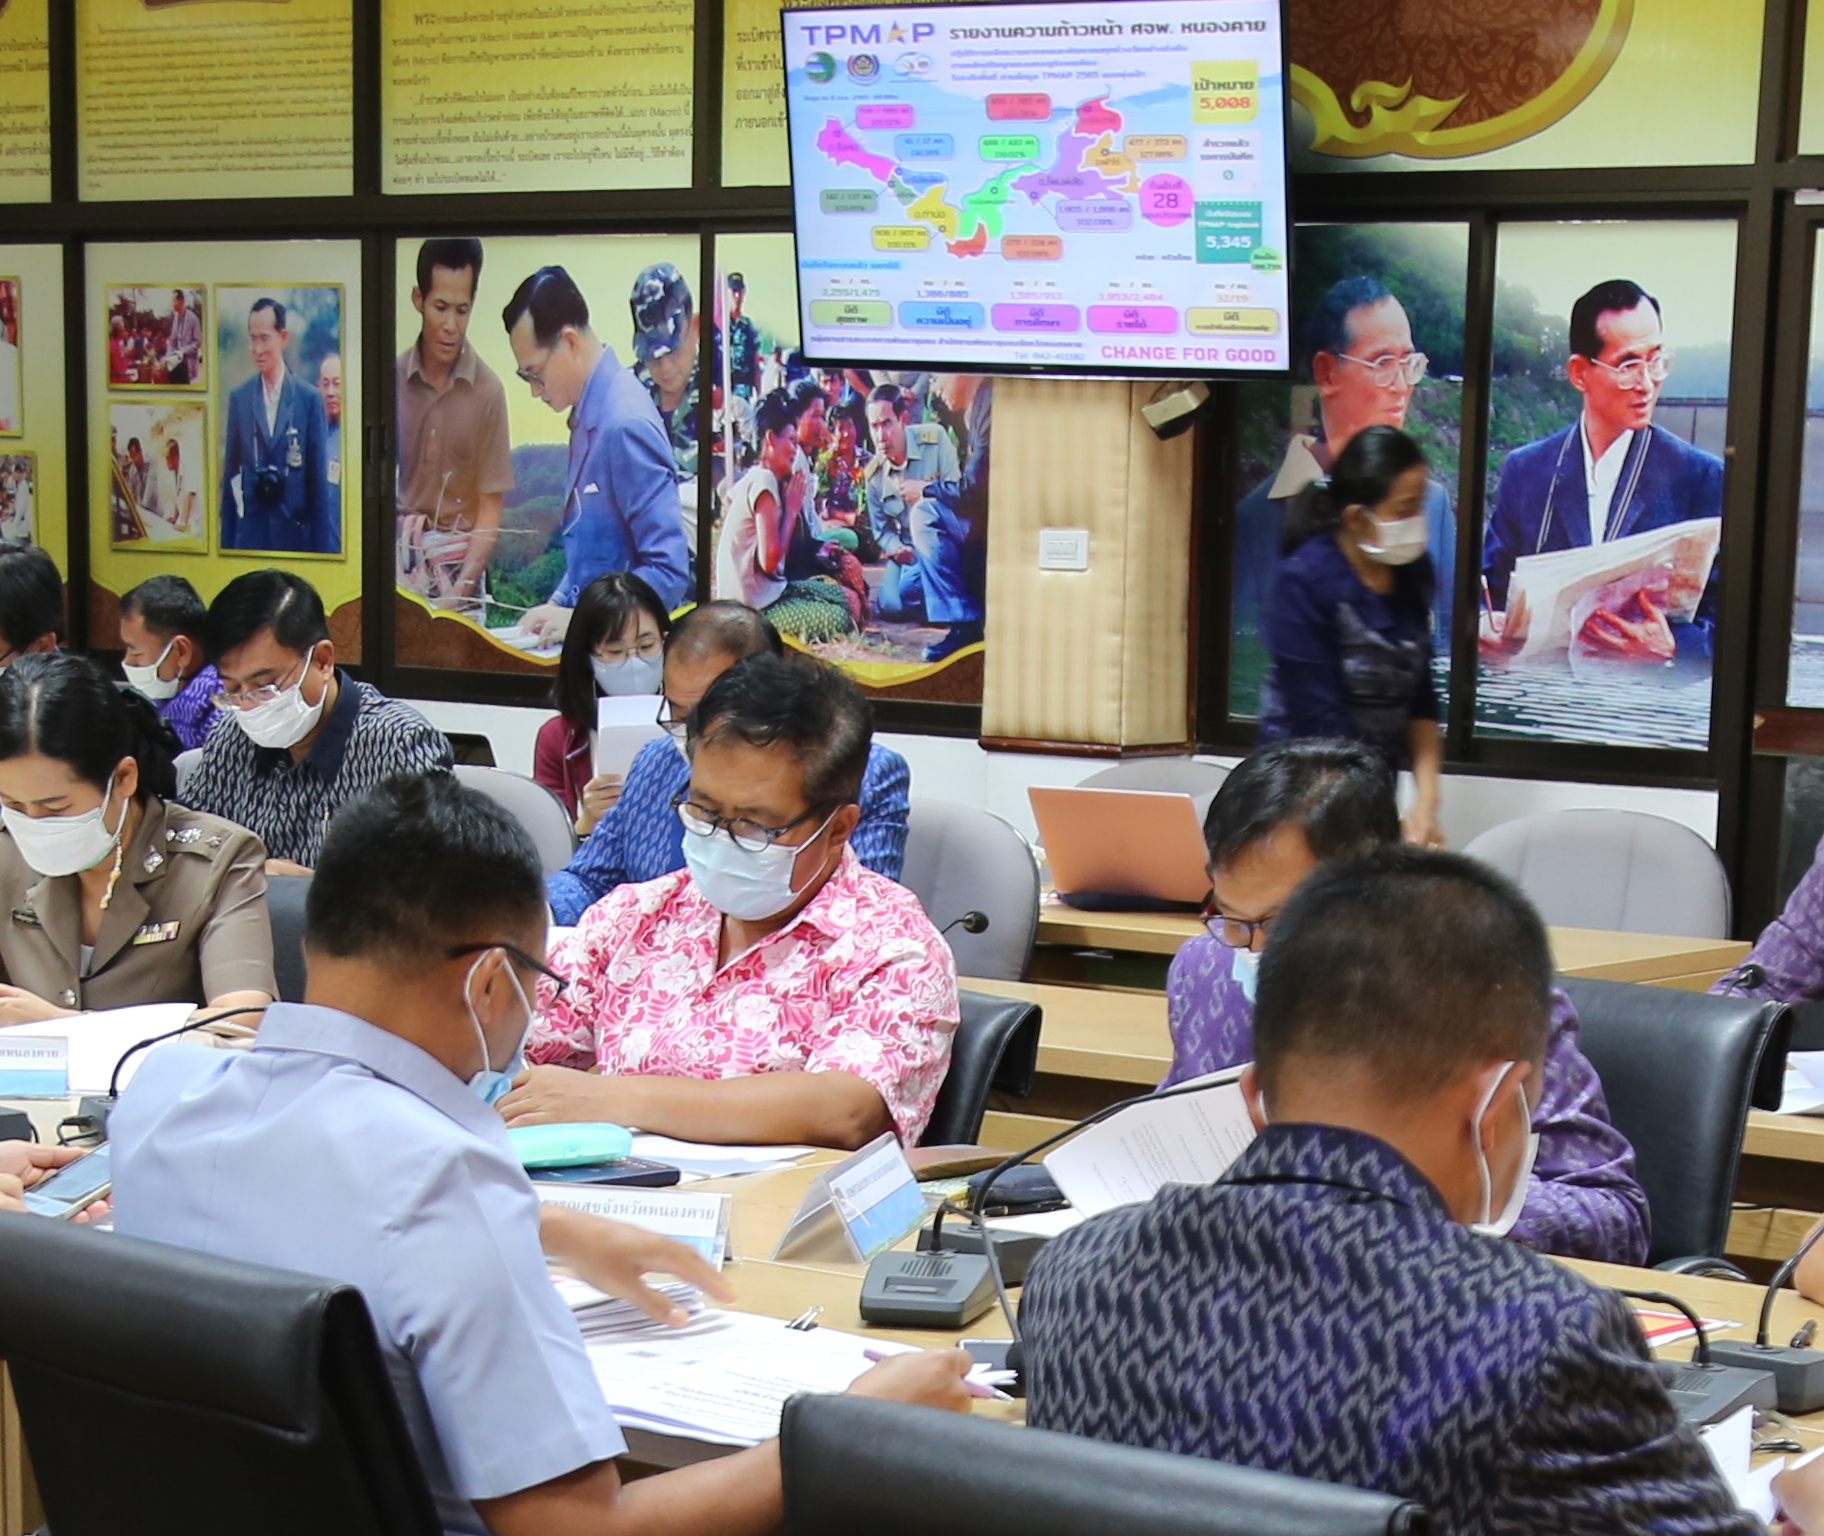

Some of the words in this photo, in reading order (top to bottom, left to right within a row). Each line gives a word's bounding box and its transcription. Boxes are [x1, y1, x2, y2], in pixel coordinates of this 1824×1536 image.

[801, 21, 935, 45] TPMAP
[949, 19, 1123, 39] รายงานความก้าวหน้า
[1131, 21, 1173, 35] ศจพ.
[1181, 20, 1266, 34] หนองคาย
[1194, 78, 1254, 91] เป้าหมาย
[1200, 97, 1251, 111] 5,008
[1153, 193, 1178, 208] 28
[1206, 235, 1252, 249] 5,345
[1101, 345, 1177, 361] CHANGE
[1182, 347, 1219, 361] FOR
[1226, 348, 1276, 363] GOOD
